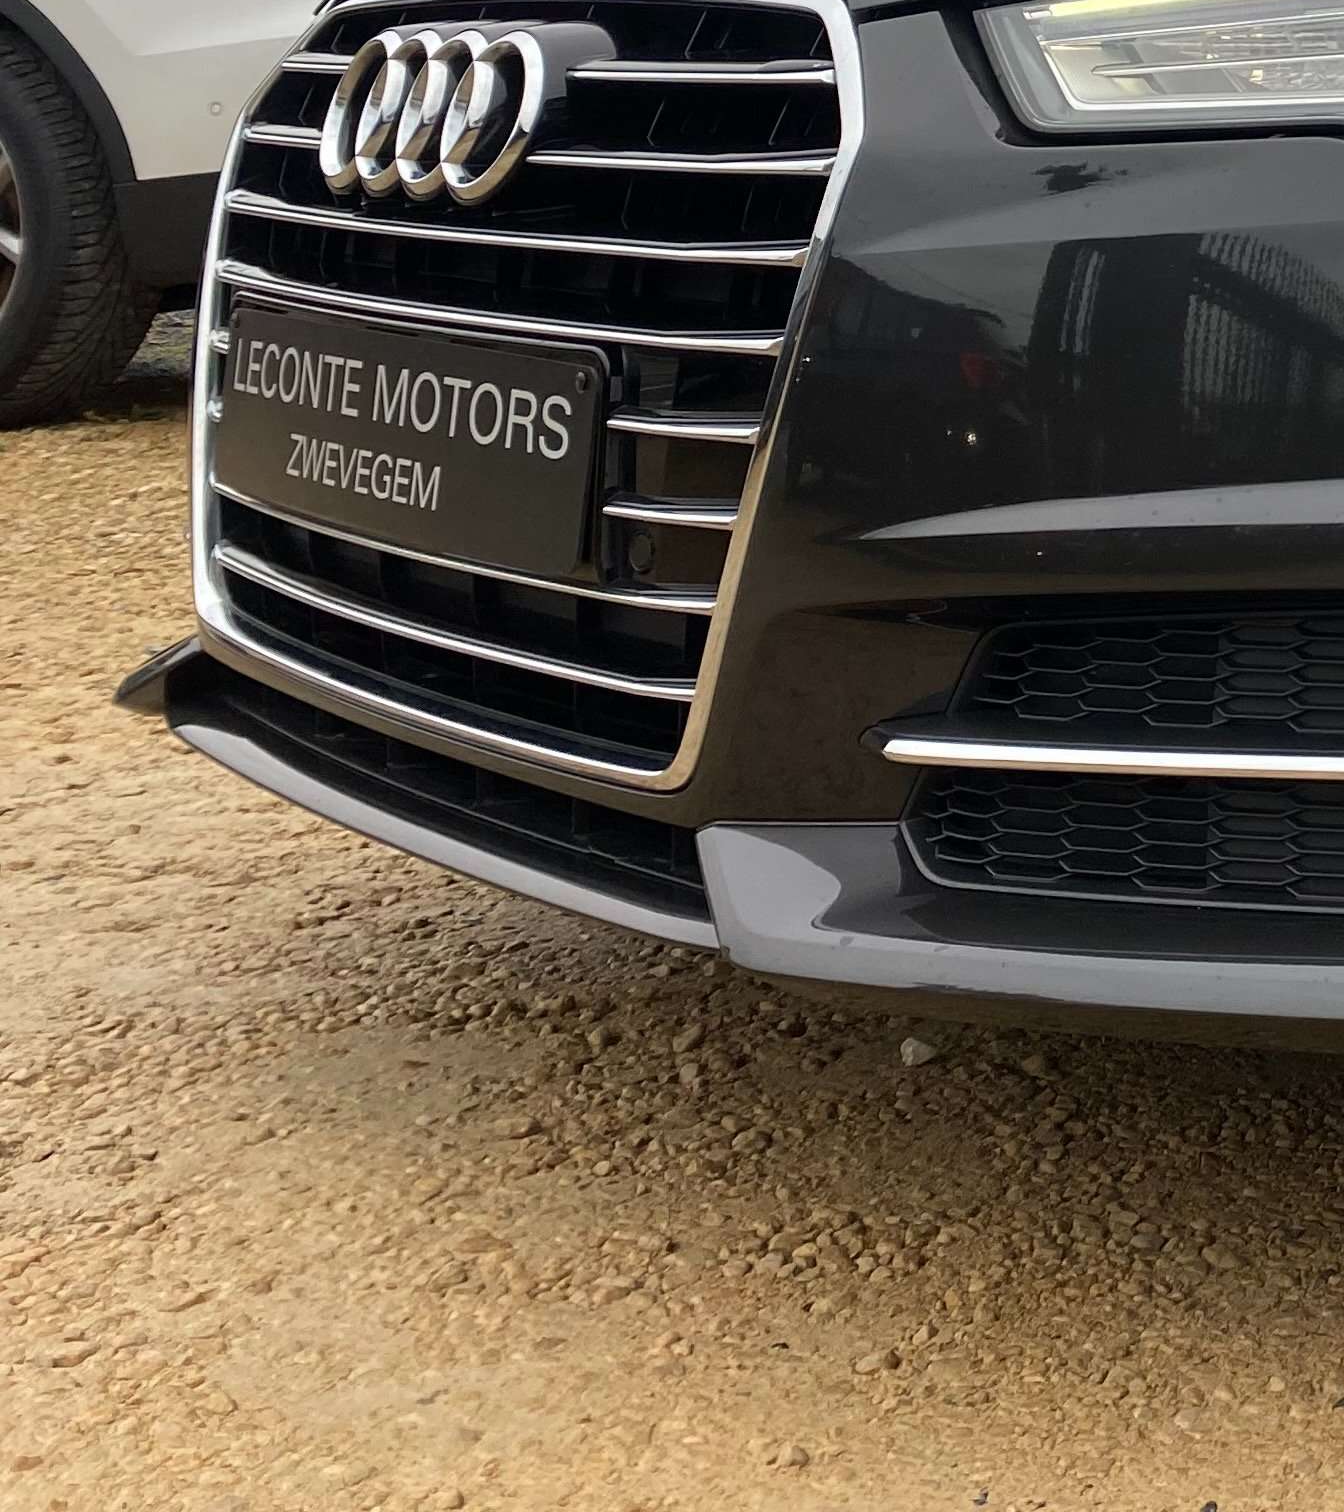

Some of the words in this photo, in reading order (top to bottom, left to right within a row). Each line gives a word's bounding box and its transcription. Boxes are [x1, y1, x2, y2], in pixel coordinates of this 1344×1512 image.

[233, 338, 364, 418] LECONTE
[372, 364, 572, 460] MOTORS
[285, 433, 441, 512] ZWEVEGEM
